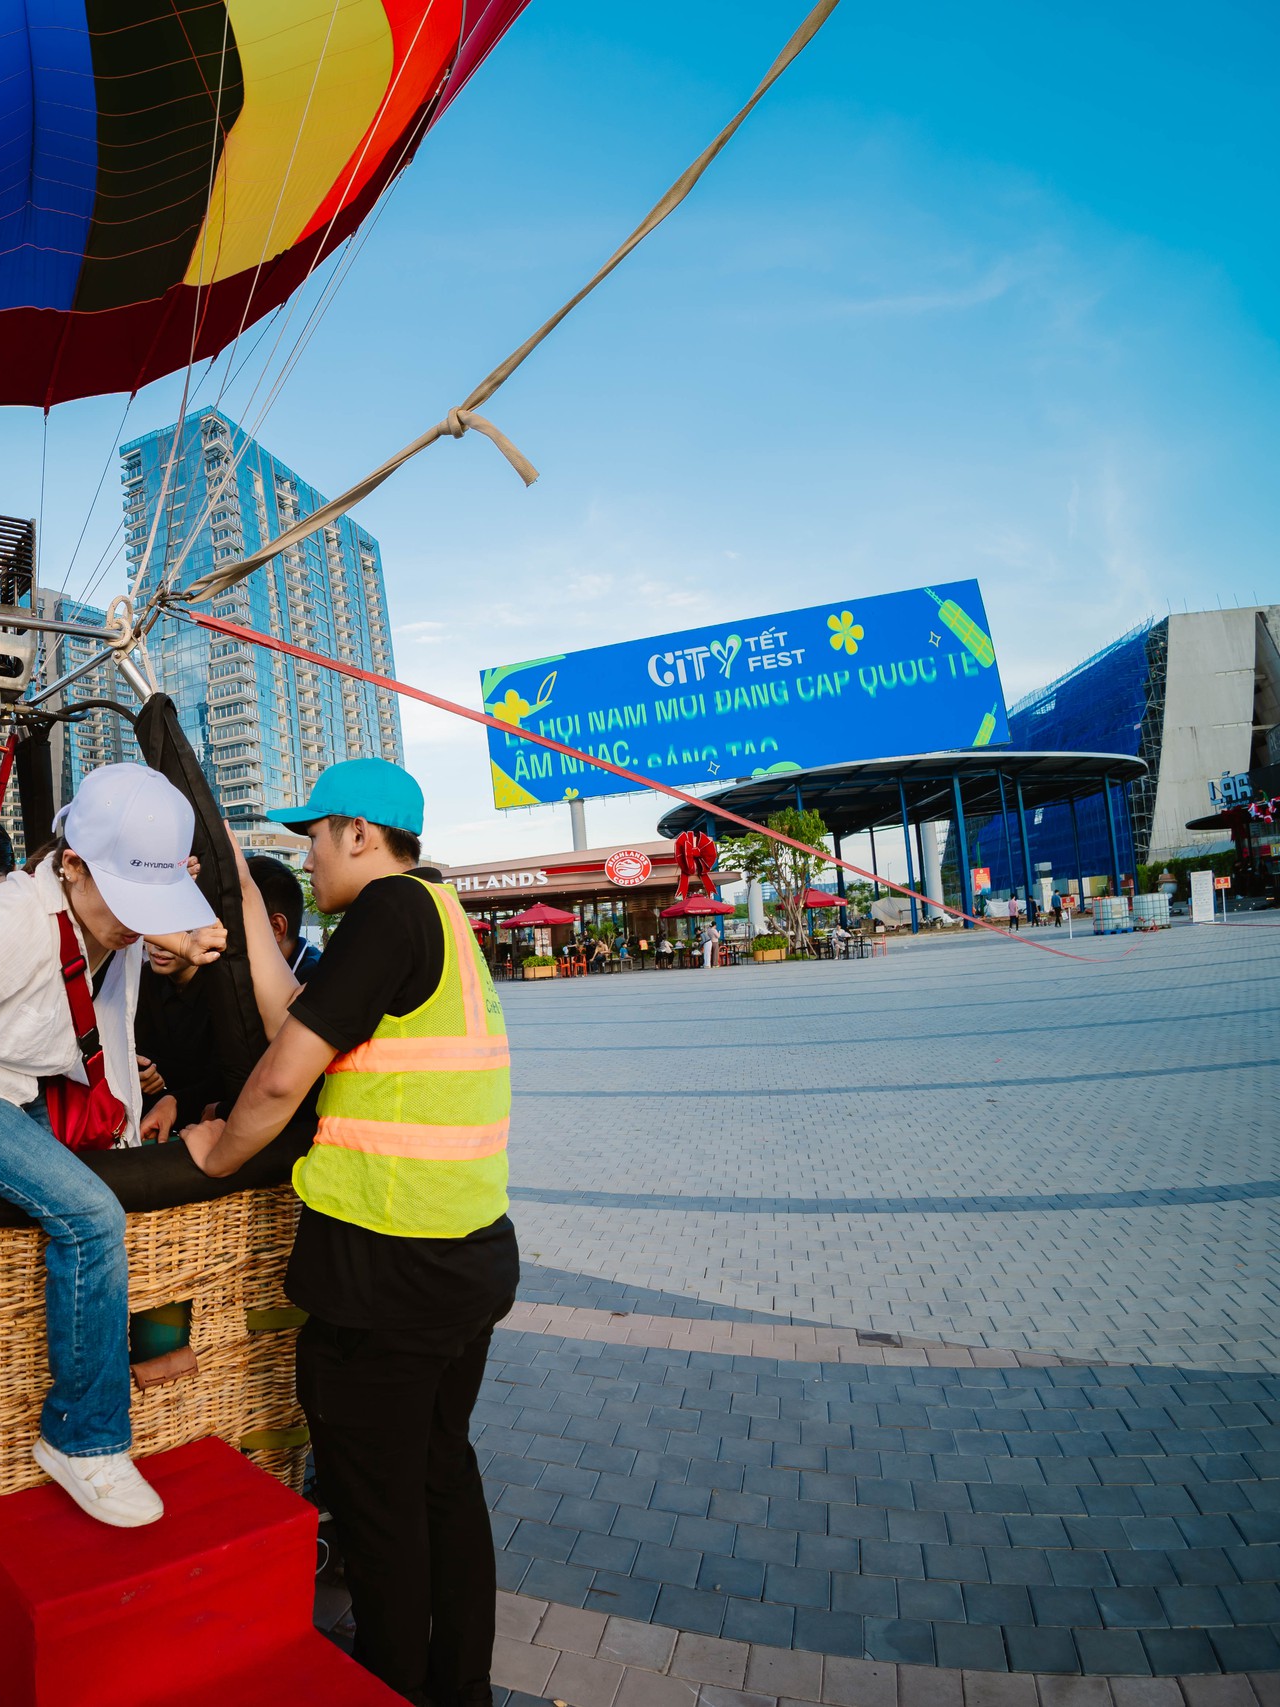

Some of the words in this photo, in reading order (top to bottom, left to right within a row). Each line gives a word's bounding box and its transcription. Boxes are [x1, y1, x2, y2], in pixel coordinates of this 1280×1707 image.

[744, 626, 788, 652] TẾT
[748, 649, 806, 672] FEST
[514, 749, 553, 782] ÂM
[607, 851, 649, 868] HIGHLANDS
[613, 874, 645, 885] COFFEE
